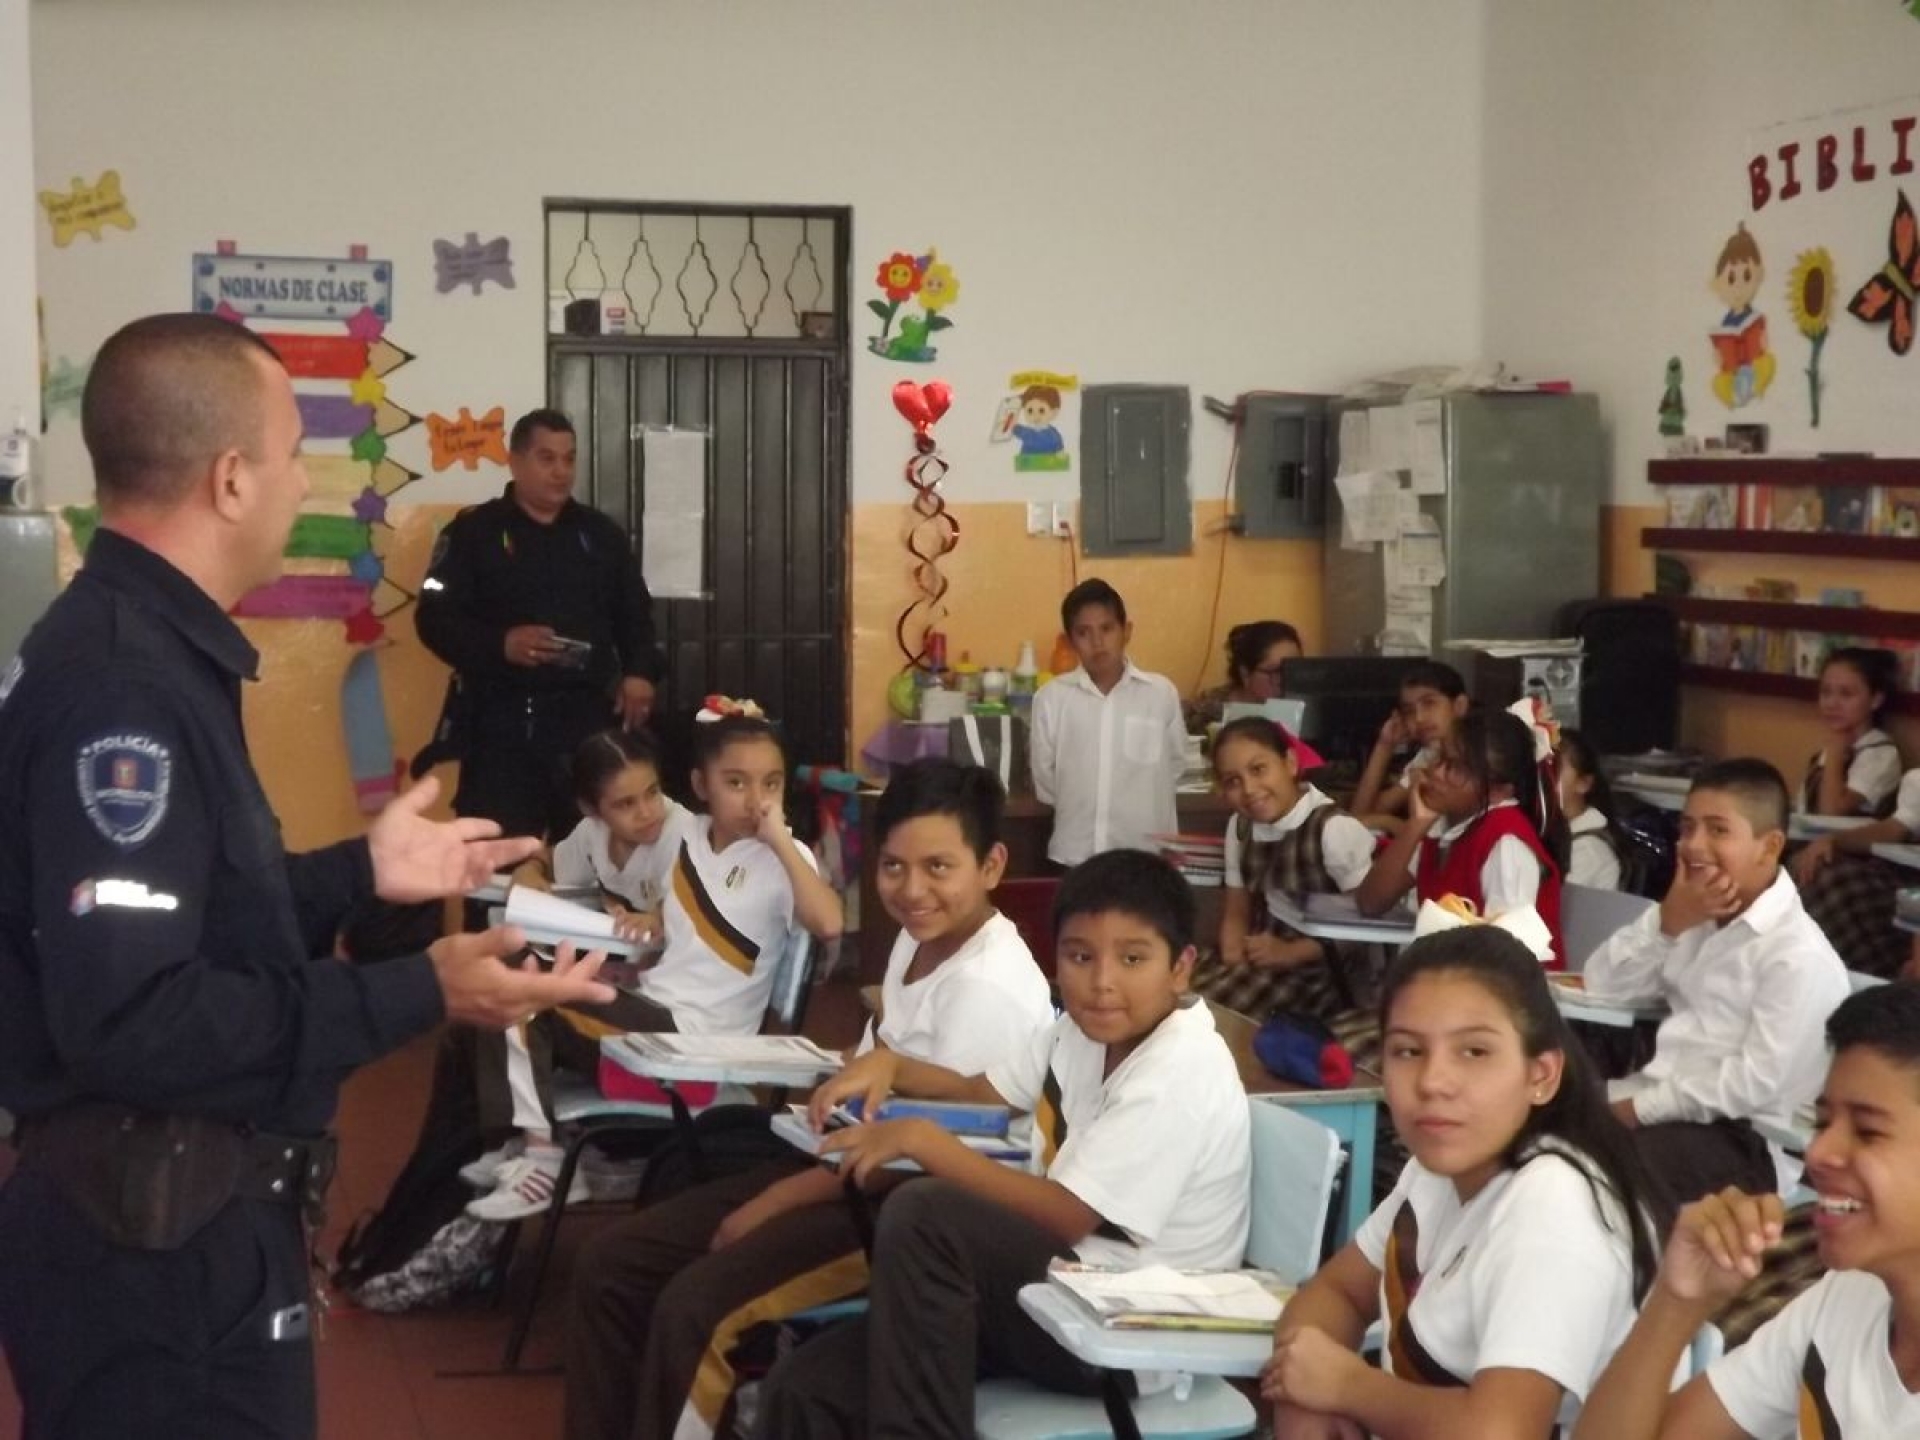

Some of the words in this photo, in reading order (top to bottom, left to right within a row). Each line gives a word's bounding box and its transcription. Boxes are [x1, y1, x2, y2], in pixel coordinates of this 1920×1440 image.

[219, 275, 288, 299] NORMAS
[291, 279, 314, 302] DE
[318, 279, 368, 303] CLASE
